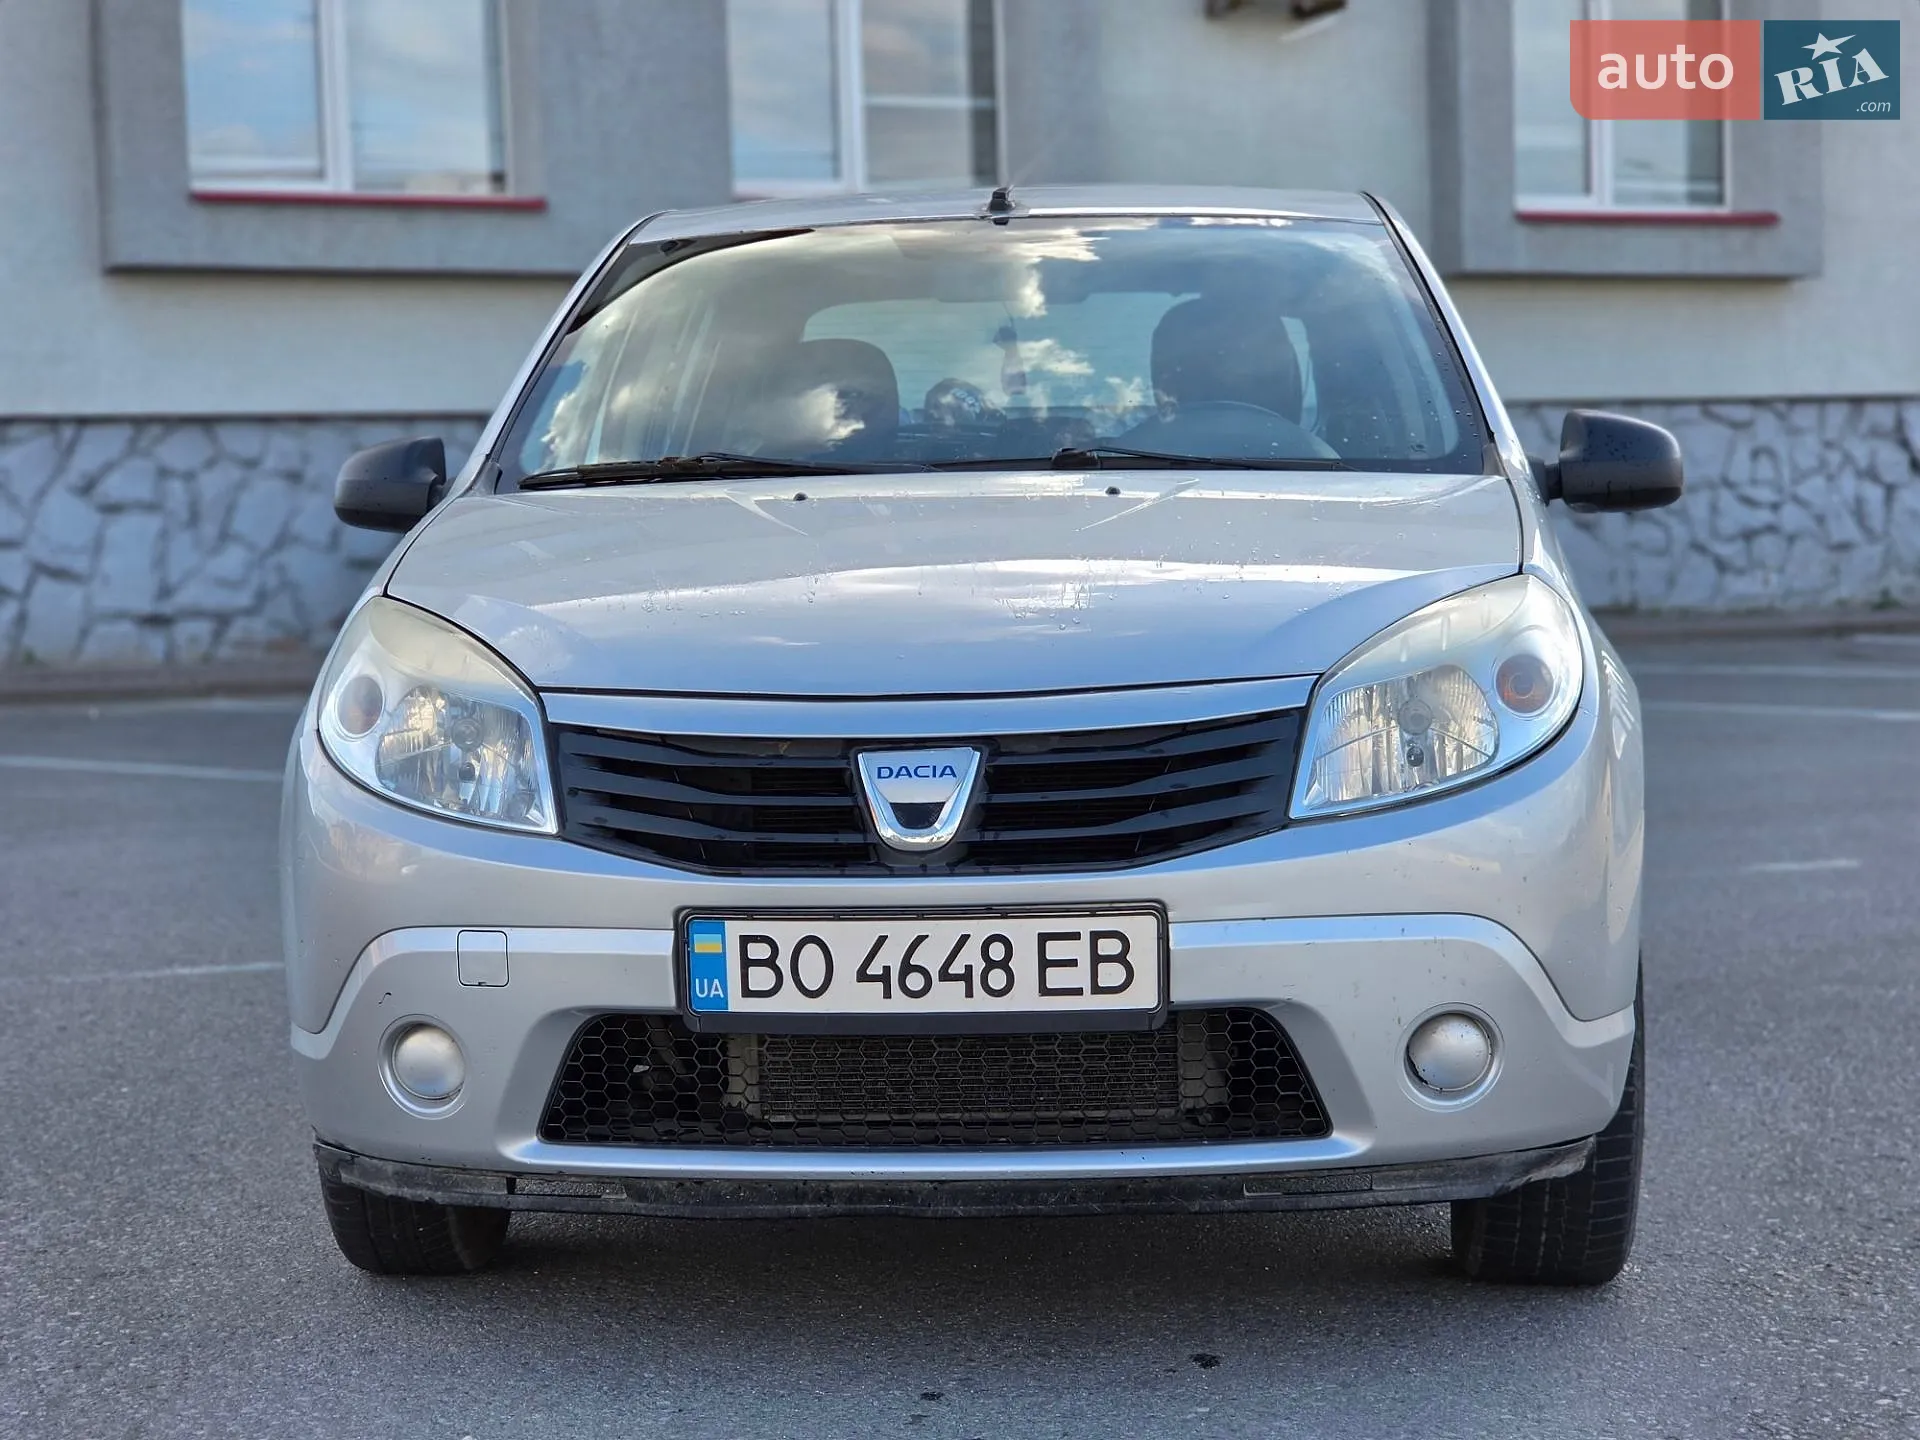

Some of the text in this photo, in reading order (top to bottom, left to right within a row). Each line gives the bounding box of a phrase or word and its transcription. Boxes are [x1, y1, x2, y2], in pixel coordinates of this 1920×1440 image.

[877, 765, 957, 779] DACIA
[738, 929, 1135, 999] BO 4648 EB
[694, 978, 725, 999] UA
